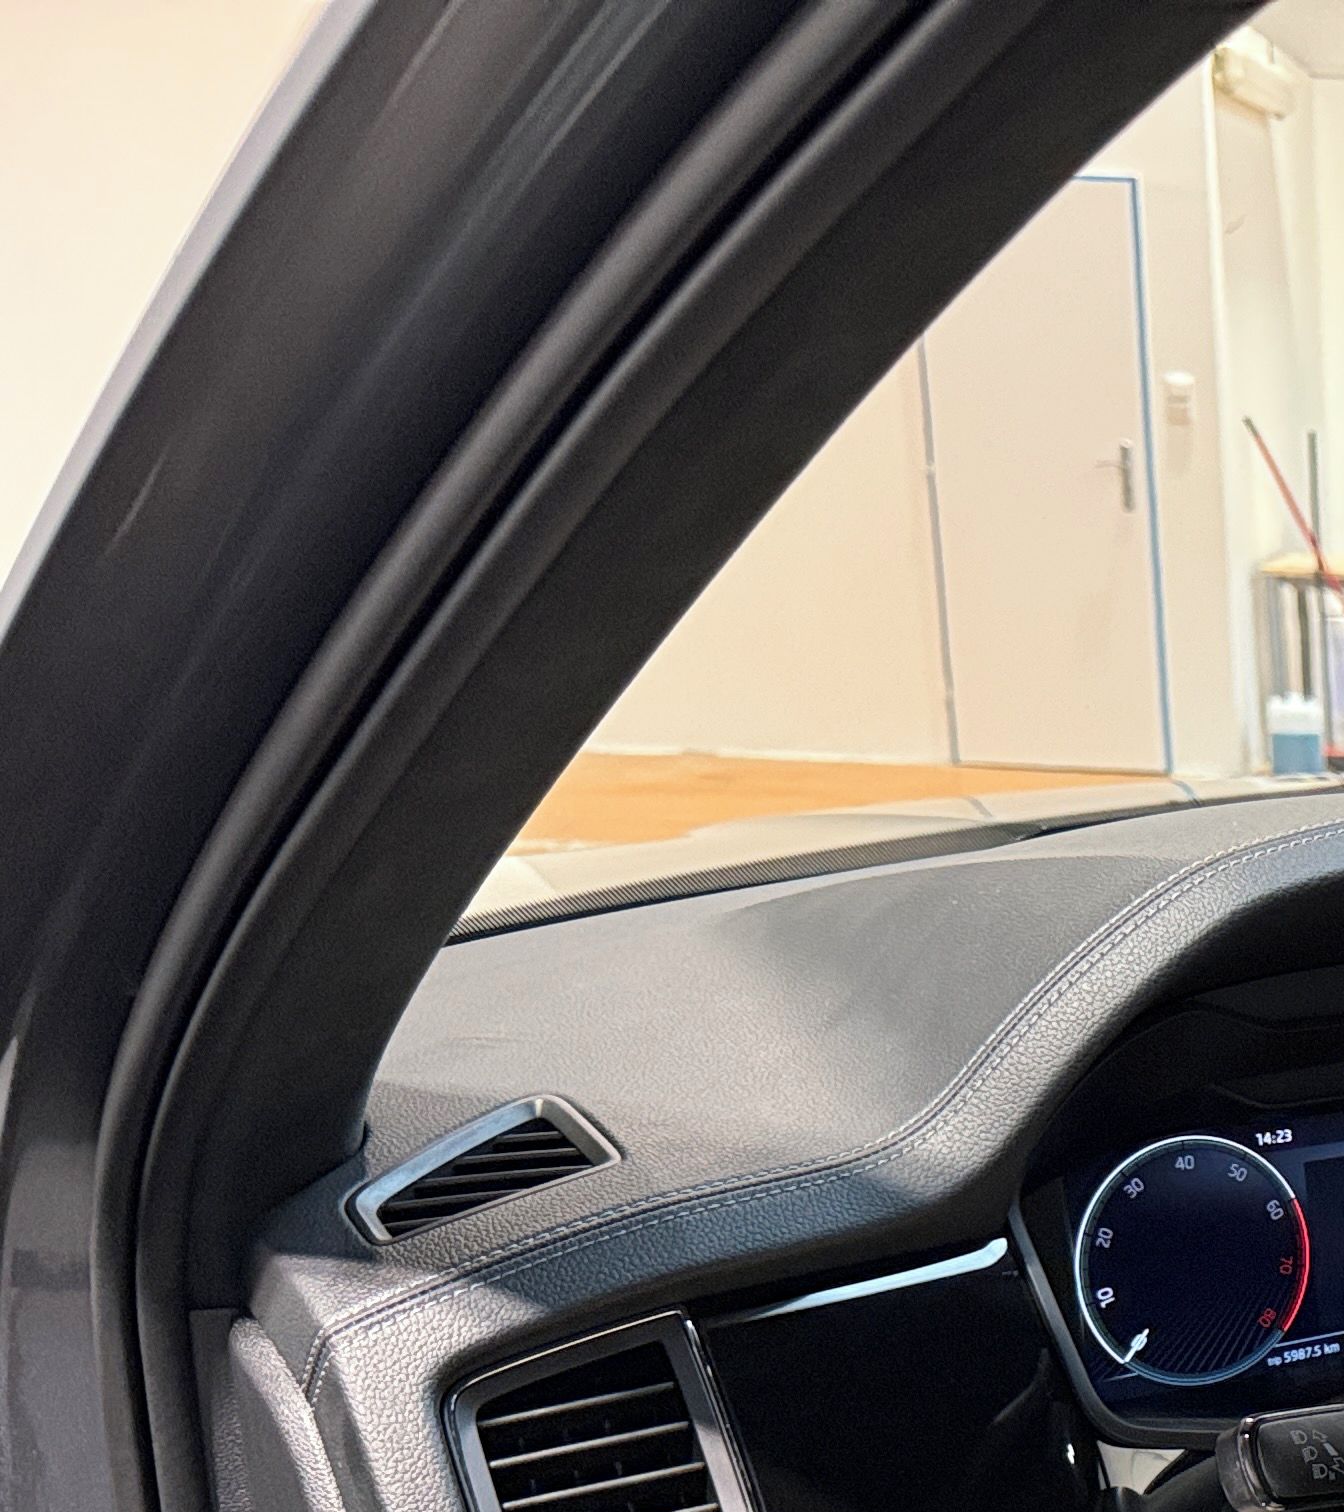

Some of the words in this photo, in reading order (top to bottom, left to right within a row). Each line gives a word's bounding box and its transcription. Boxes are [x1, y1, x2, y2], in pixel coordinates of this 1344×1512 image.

[1255, 1128, 1293, 1146] 14:23
[1174, 1155, 1195, 1171] 40
[1227, 1163, 1248, 1182] 50
[1123, 1177, 1145, 1199] 30
[1266, 1199, 1285, 1221] 60
[1095, 1227, 1114, 1249] 20
[1279, 1256, 1294, 1276] 70
[1097, 1287, 1115, 1309] 10
[1258, 1307, 1277, 1329] 80
[1283, 1344, 1322, 1364] 5987.5
[1323, 1342, 1340, 1355] km
